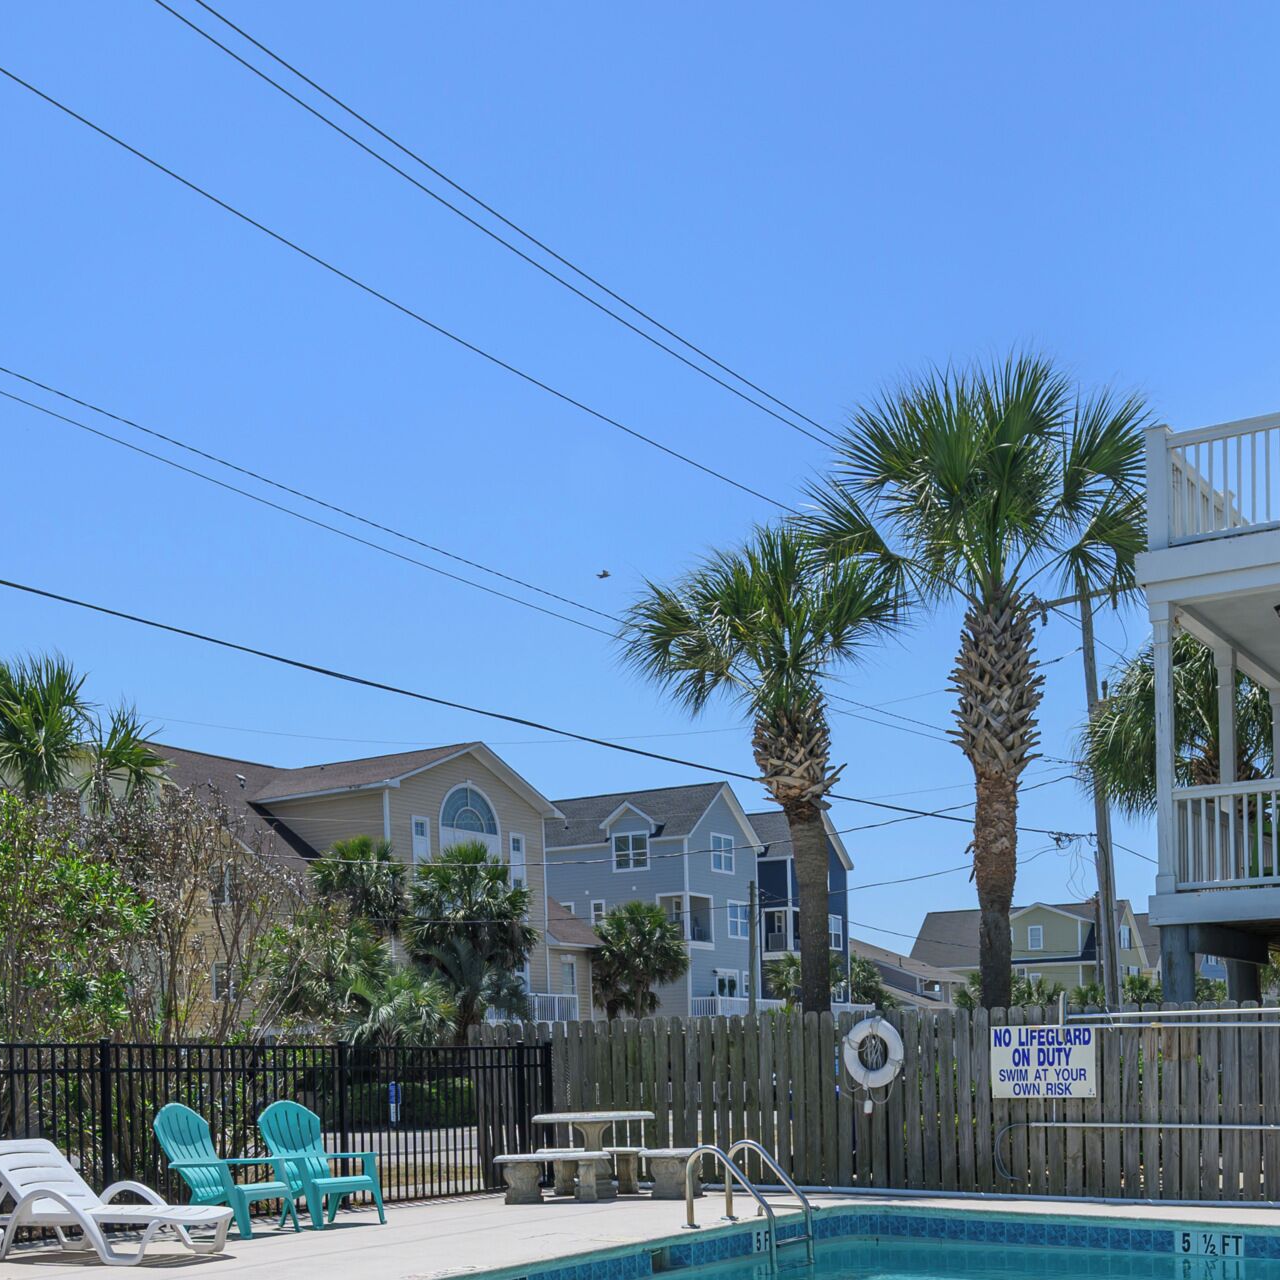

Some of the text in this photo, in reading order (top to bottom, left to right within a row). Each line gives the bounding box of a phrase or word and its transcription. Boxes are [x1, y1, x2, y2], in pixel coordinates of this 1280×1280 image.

[993, 1028, 1012, 1047] NO
[1012, 1047, 1072, 1067] ON DUTY
[999, 1068, 1087, 1082] SWIM AT YOUR
[1013, 1082, 1072, 1096] OWN RISK
[1181, 1232, 1191, 1253] 5
[1221, 1234, 1243, 1256] FT
